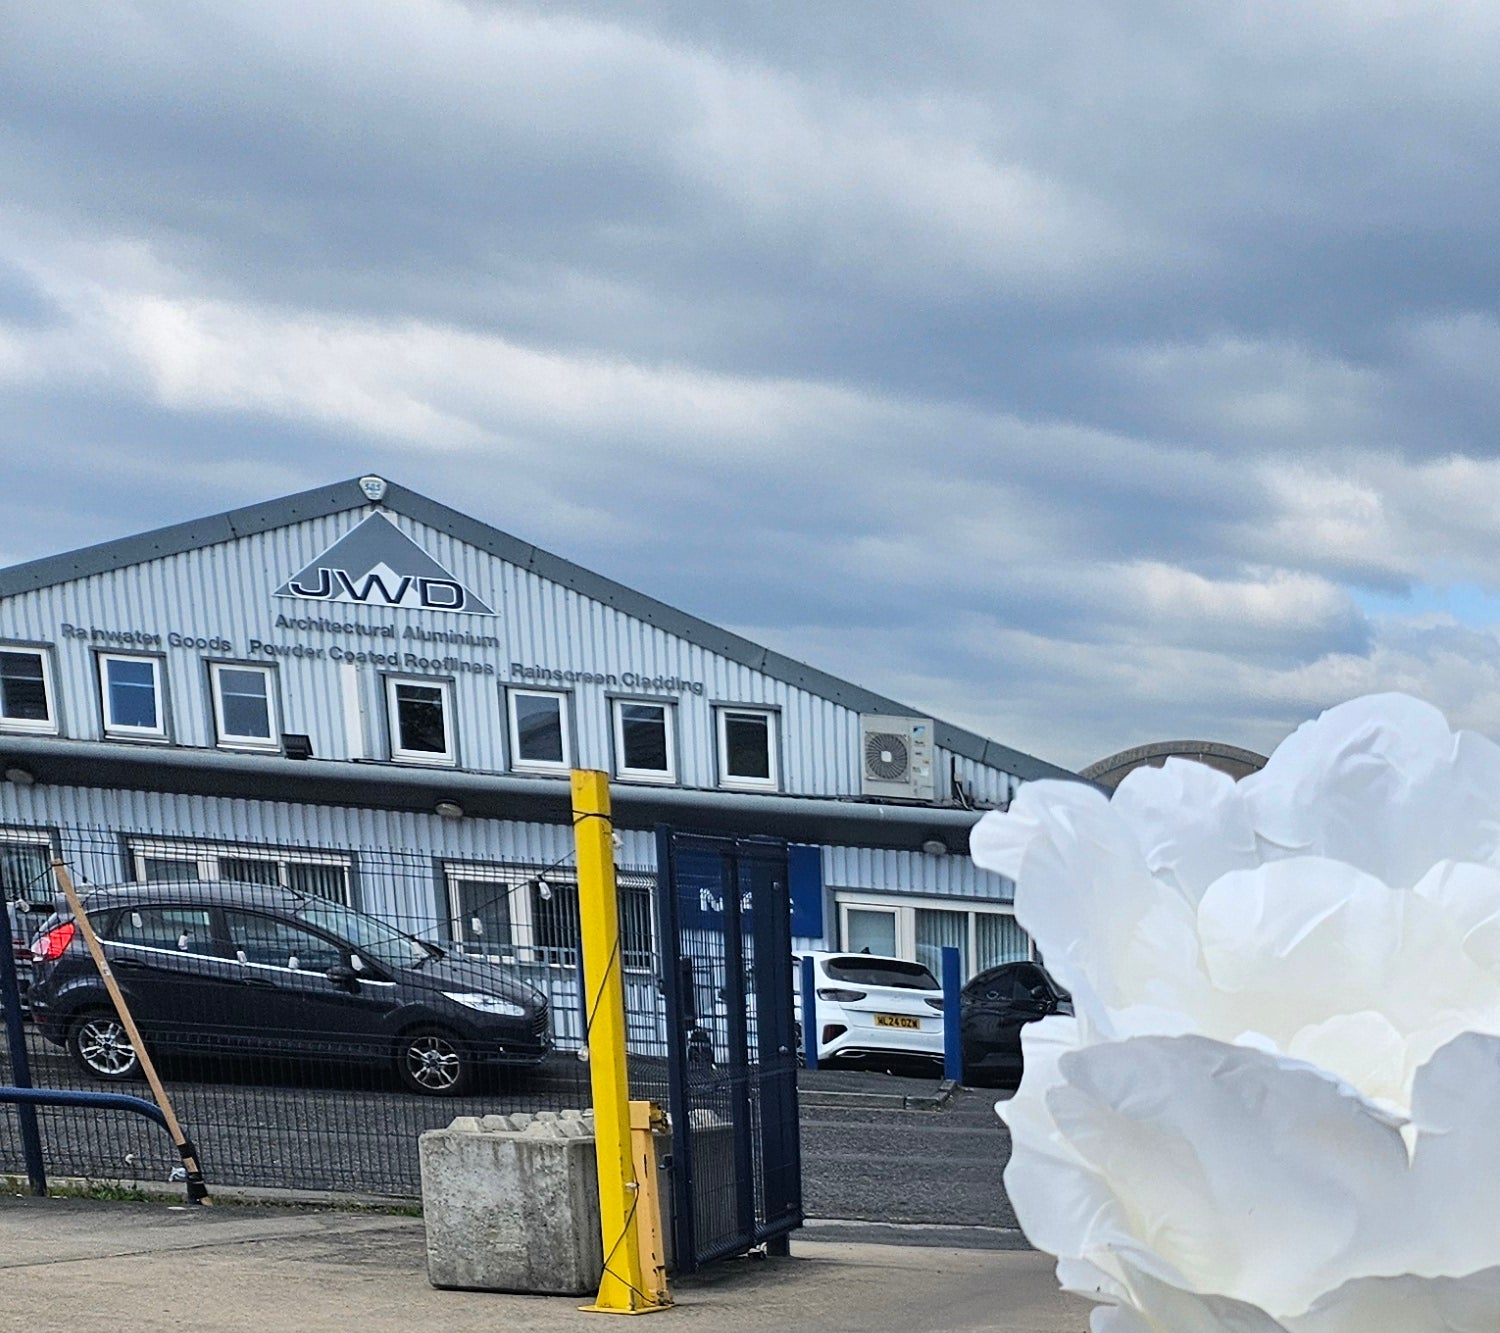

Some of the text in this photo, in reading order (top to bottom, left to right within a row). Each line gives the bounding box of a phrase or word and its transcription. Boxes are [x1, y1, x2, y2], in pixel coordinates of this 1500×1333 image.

[288, 567, 466, 610] JWD
[274, 613, 500, 648] Architectural Aluminium
[60, 622, 705, 697] Rainwater Goods Powder Coated Rooflines Rainscreen Cladding
